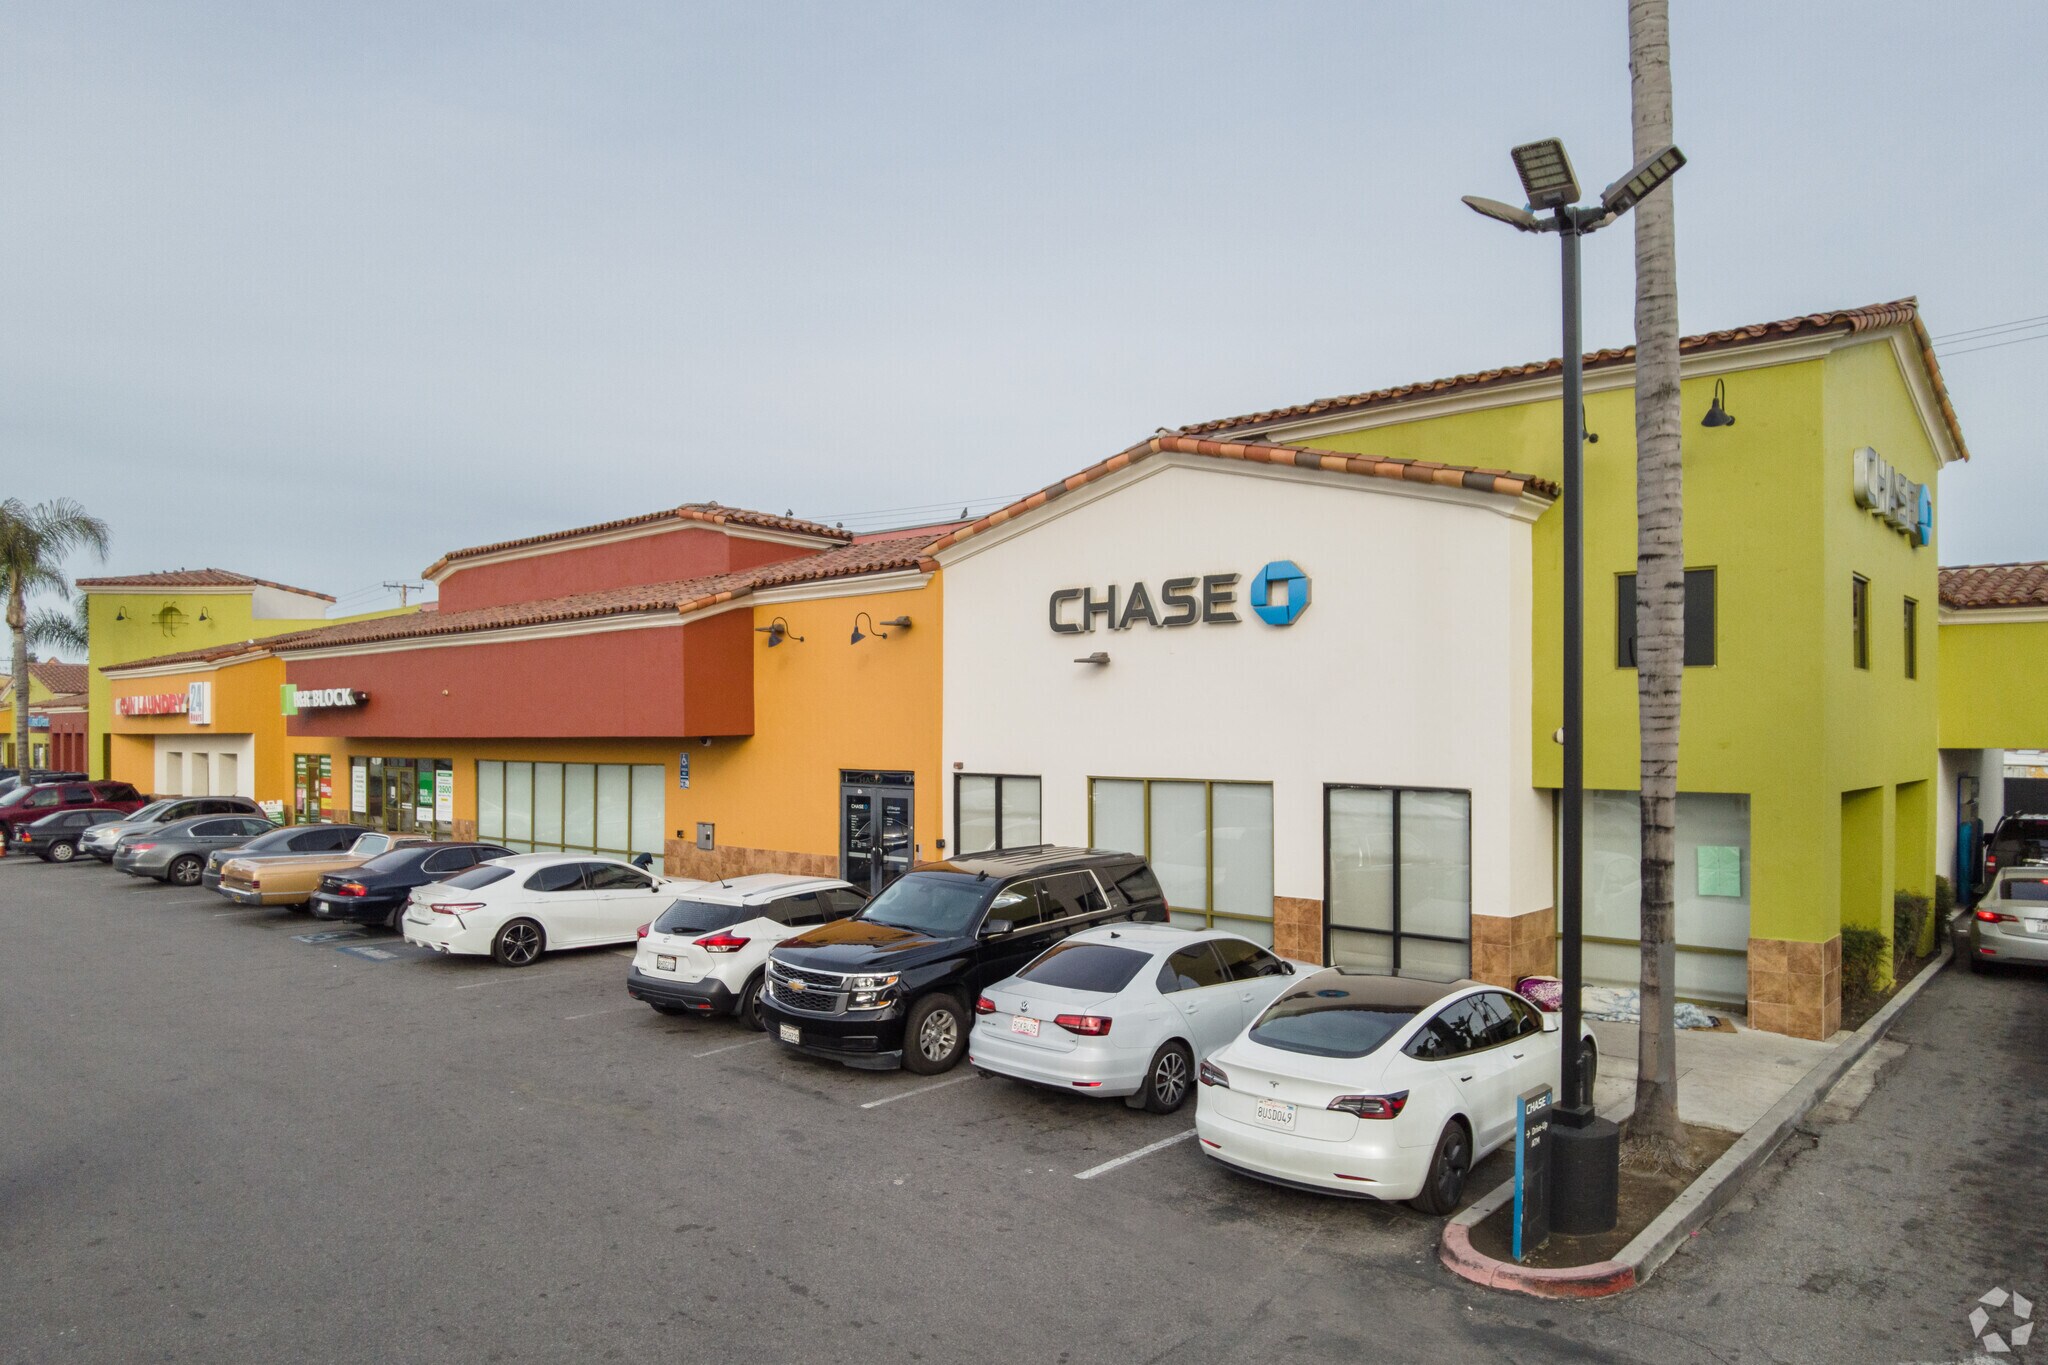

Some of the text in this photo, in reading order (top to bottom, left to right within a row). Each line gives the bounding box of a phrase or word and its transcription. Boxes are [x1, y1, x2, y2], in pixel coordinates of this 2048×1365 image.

[1854, 446, 1918, 534] CHASE
[1049, 572, 1243, 634] CHASE
[120, 693, 187, 715] COIN LAUNDRY
[190, 684, 202, 712] 24
[312, 687, 354, 706] BLOCK
[1257, 1106, 1293, 1123] 8USD049
[1526, 1096, 1546, 1114] CHASE
[1531, 1136, 1540, 1147] ATM
